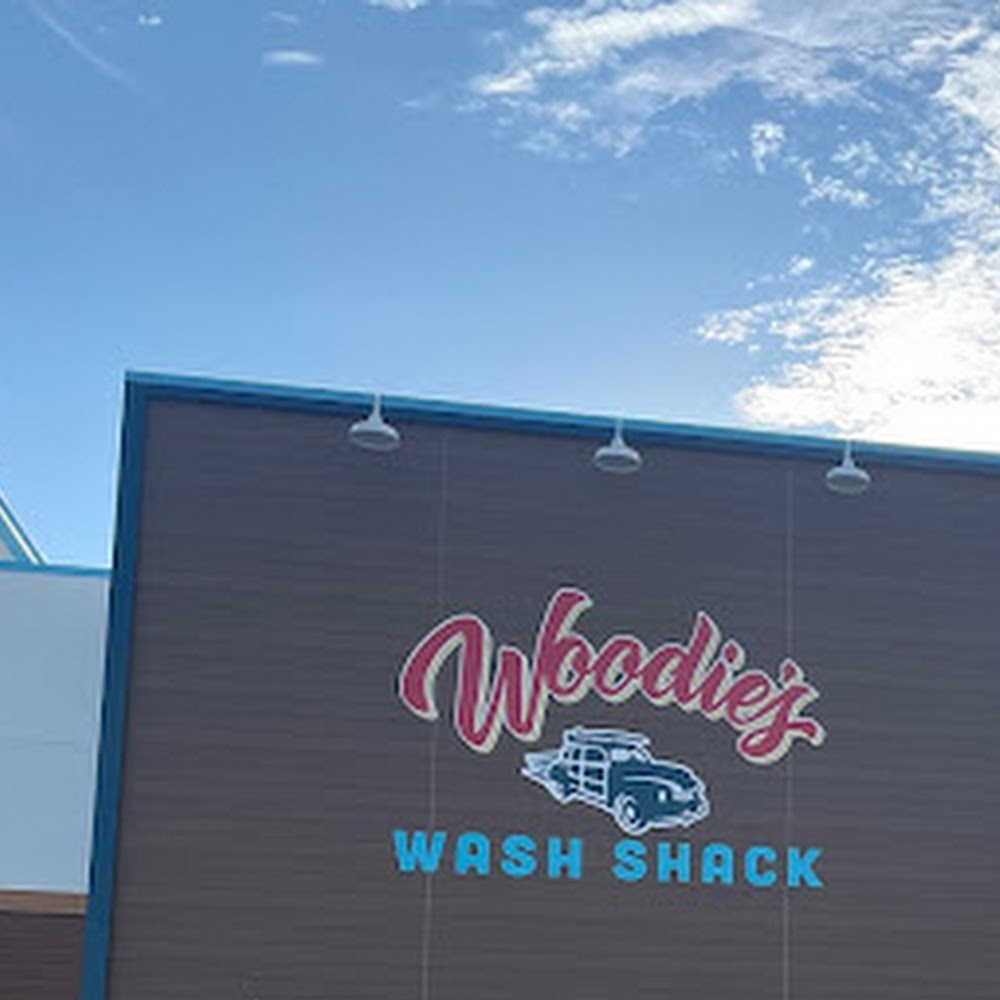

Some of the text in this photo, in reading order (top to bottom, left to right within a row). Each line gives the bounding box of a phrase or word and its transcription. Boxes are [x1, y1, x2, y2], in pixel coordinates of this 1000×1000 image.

[397, 586, 827, 766] Woodie's
[392, 829, 825, 888] WASH SHACK
